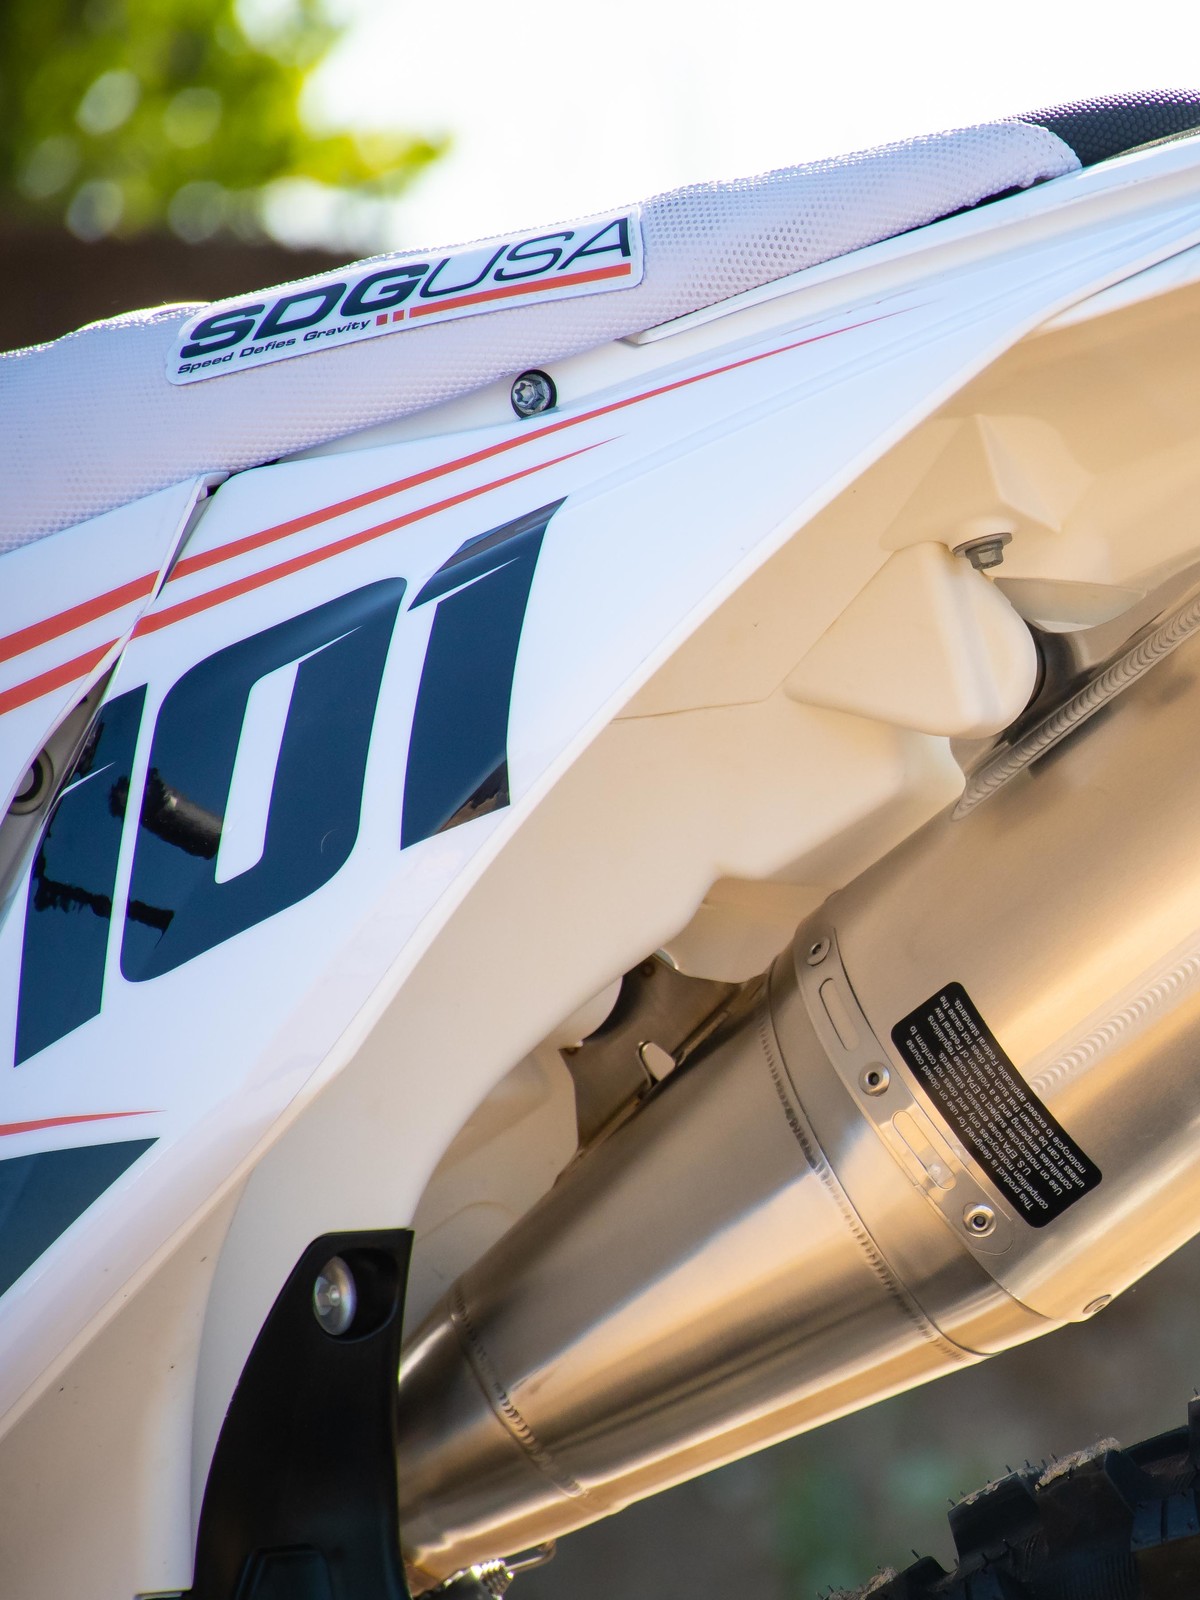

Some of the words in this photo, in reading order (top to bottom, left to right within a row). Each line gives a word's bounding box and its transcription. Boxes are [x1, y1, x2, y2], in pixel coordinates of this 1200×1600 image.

[177, 351, 235, 375] Speed
[239, 337, 297, 358] Defies
[303, 318, 371, 342] Gravity
[940, 995, 950, 1009] the
[934, 1007, 945, 1022] law
[948, 1009, 964, 1032] cause
[954, 998, 980, 1037] standards.
[910, 1026, 918, 1035] to
[927, 1015, 955, 1056] regulations
[942, 1021, 964, 1051] Federal
[961, 1031, 973, 1045] not
[906, 1039, 924, 1065] course
[915, 1034, 936, 1065] conform
[959, 1049, 969, 1058] of
[971, 1044, 986, 1064] does
[976, 1036, 999, 1066] Federal
[933, 1064, 945, 1078] not
[939, 1050, 966, 1089] standards.
[953, 1056, 969, 1076] noise
[967, 1058, 990, 1089] violation
[984, 1064, 996, 1079] use
[921, 1065, 941, 1090] closed
[943, 1077, 958, 1097] does
[966, 1075, 981, 1094] EPA
[994, 1078, 1009, 1097] such
[998, 1065, 1026, 1102] applicable
[939, 1089, 948, 1101] on
[955, 1096, 969, 1112] and
[979, 1093, 987, 1102] to
[994, 1095, 1001, 1103] is
[1007, 1096, 1021, 1113] that
[947, 1101, 959, 1115] use
[964, 1089, 989, 1122] emission
[985, 1101, 1007, 1128] subject
[998, 1103, 1013, 1118] and
[1023, 1102, 1047, 1129] exceed
[957, 1116, 967, 1127] for
[967, 1112, 981, 1128] only
[1019, 1112, 1040, 1136] shown
[987, 1122, 1005, 1142] noise
[1011, 1117, 1041, 1154] tampering
[1038, 1135, 1048, 1147] be
[1046, 1128, 1054, 1138] to
[964, 1126, 992, 1159] designed
[979, 1128, 1015, 1171] motorcycles
[1003, 1141, 1018, 1159] EPA
[1006, 1128, 1042, 1170] motorcycles
[1047, 1145, 1060, 1160] can
[991, 1159, 999, 1168] is
[1053, 1136, 1086, 1174] motorcycle
[1017, 1158, 1031, 1176] U.S.
[1039, 1153, 1073, 1190] constitutes
[1040, 1169, 1050, 1180] on
[1063, 1165, 1085, 1188] unless
[996, 1166, 1022, 1194] product
[1013, 1170, 1049, 1209] competition
[1048, 1180, 1063, 1196] Use
[1019, 1193, 1034, 1210] This
